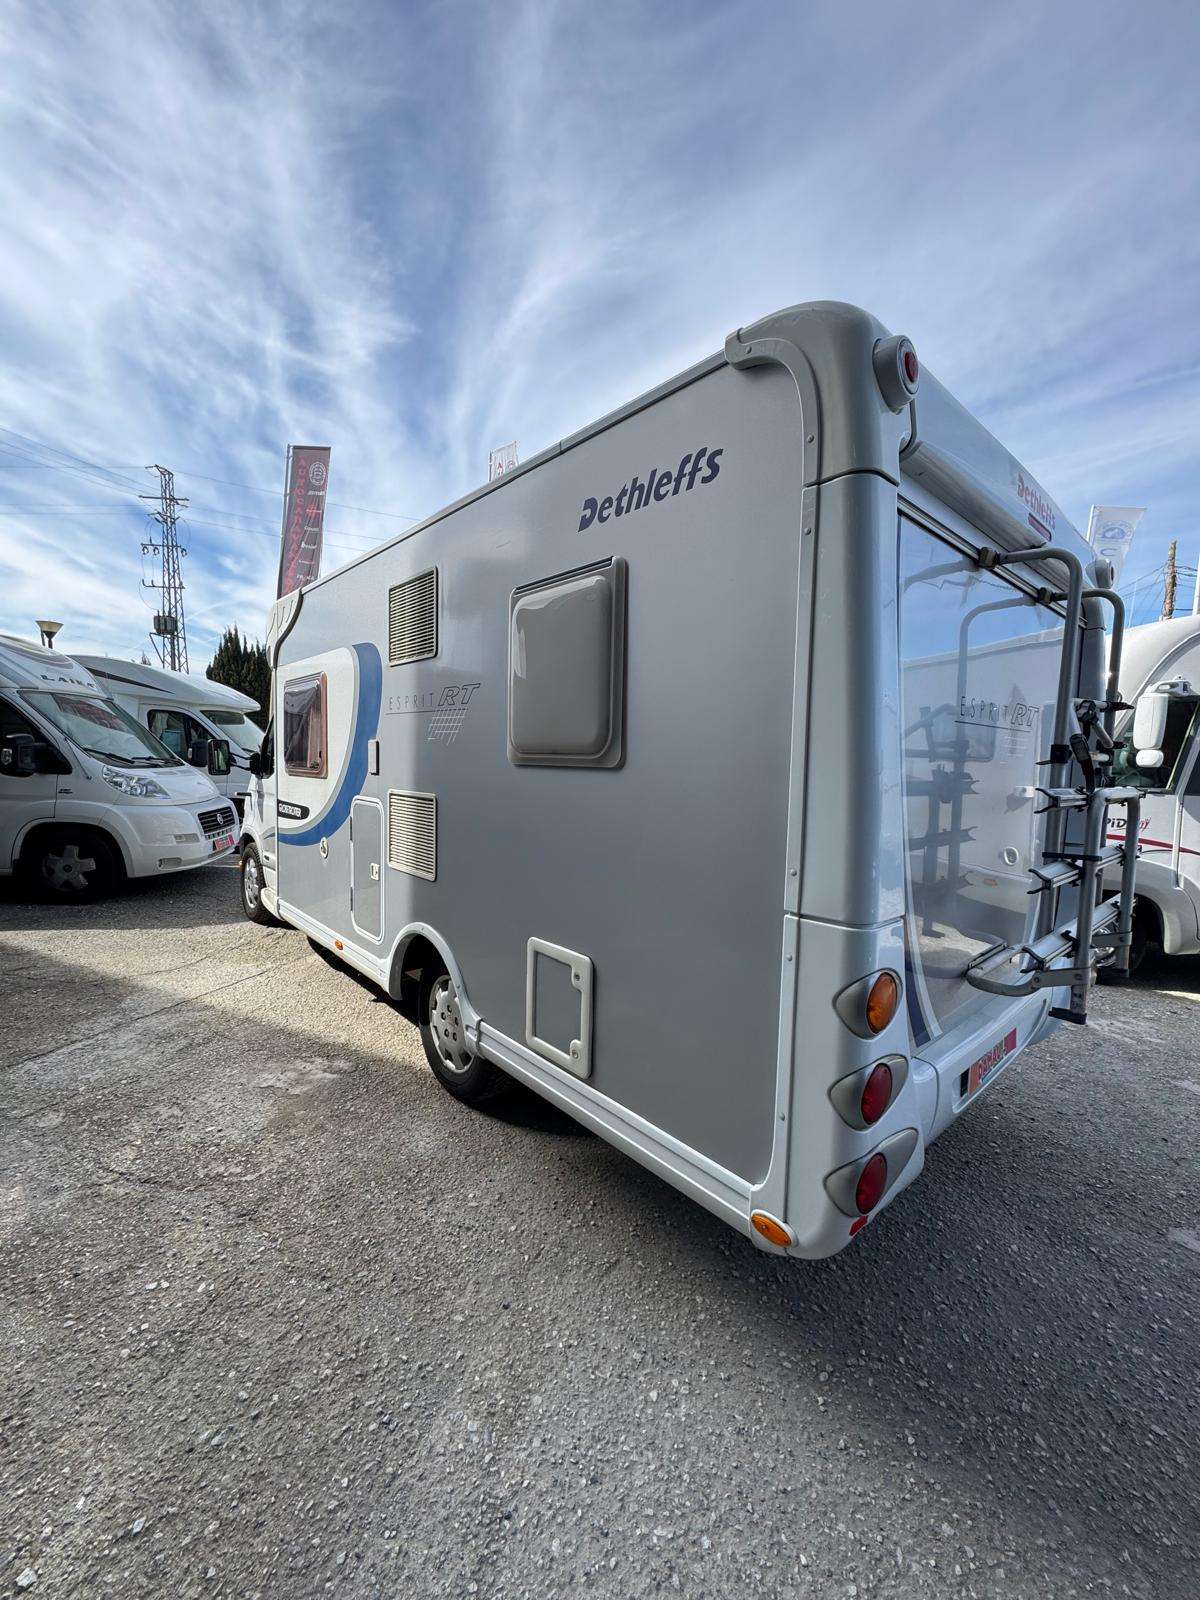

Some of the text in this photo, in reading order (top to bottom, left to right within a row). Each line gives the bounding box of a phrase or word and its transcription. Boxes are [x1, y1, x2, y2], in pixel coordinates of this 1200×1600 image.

[578, 446, 724, 533] Dethleffs
[1017, 473, 1056, 530] Dethleffs
[389, 683, 481, 711] ESPRIT RT
[960, 696, 1040, 727] ESPRIT RT
